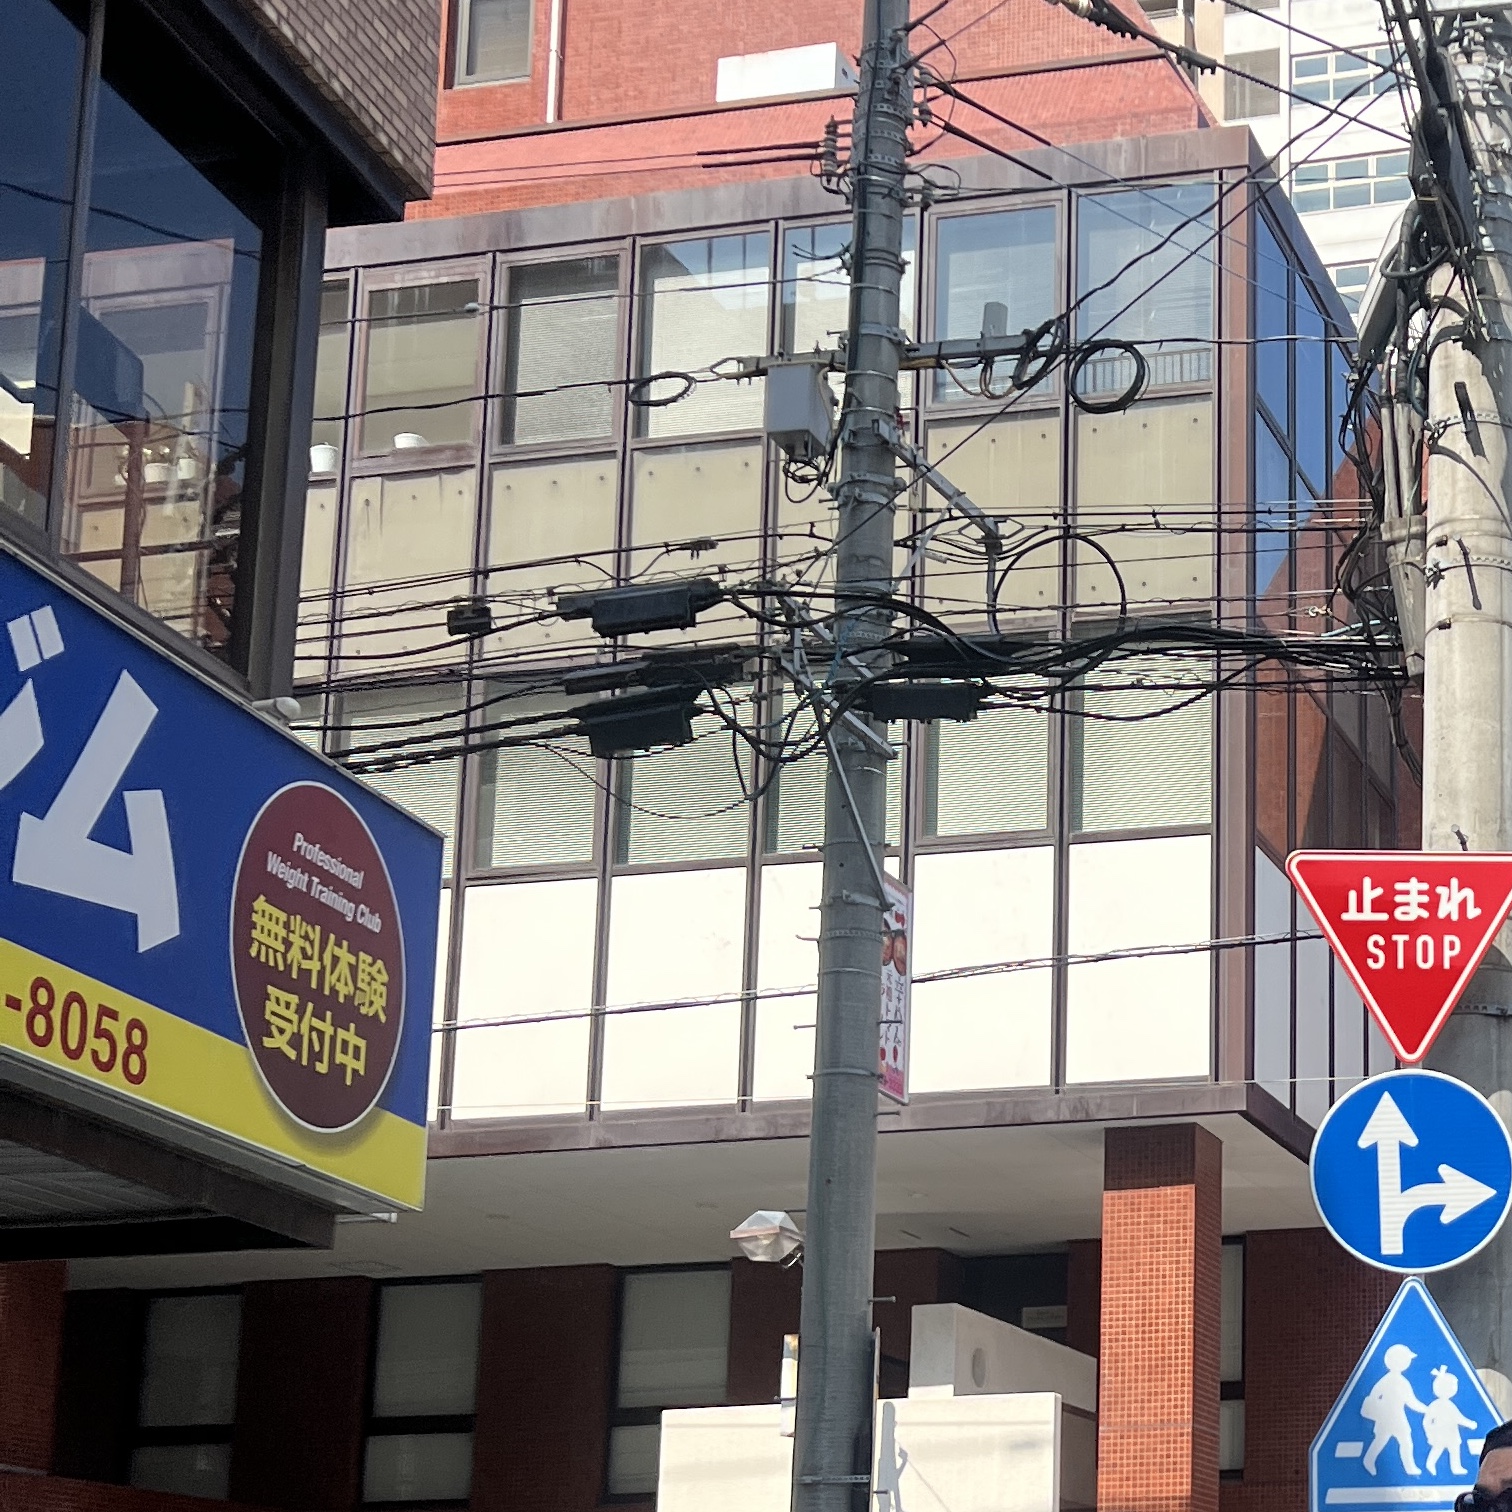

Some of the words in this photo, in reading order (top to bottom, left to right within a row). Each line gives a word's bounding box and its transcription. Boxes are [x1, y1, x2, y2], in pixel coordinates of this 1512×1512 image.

[266, 851, 310, 893] Weight
[310, 876, 356, 922] Training
[356, 903, 383, 934] Club
[292, 832, 364, 890] Professional
[1340, 876, 1482, 922] 止まれ
[249, 894, 390, 1024] 無料体験
[1366, 933, 1462, 970] STOP
[262, 984, 367, 1087] 受付中
